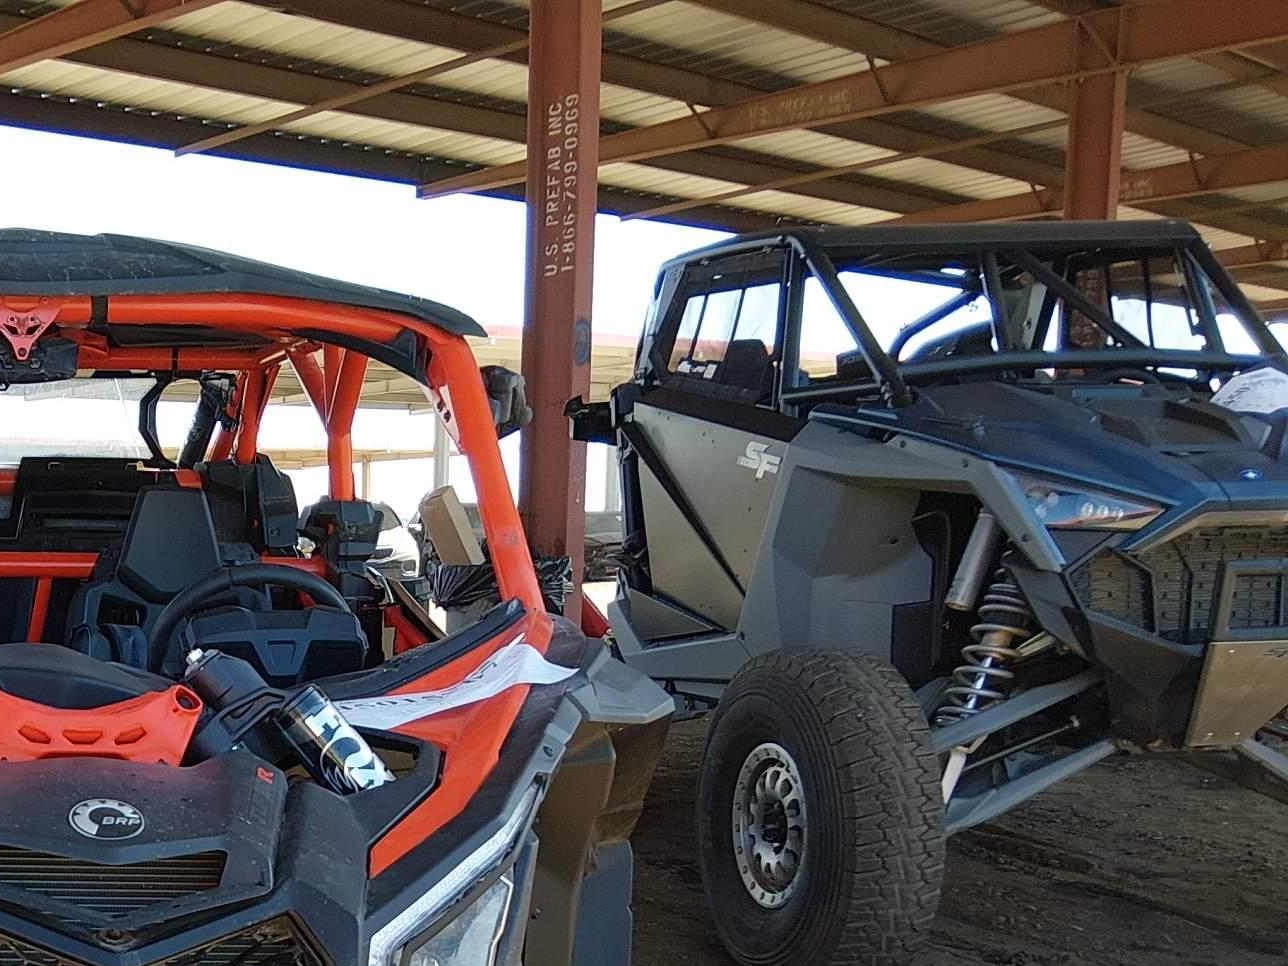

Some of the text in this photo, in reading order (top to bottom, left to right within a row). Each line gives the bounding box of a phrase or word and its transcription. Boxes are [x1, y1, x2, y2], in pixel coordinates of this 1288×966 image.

[546, 148, 562, 225] PREFAB
[561, 93, 580, 272] 1-866-799-0969
[544, 237, 559, 277] U.S.
[101, 815, 142, 828] BRP
